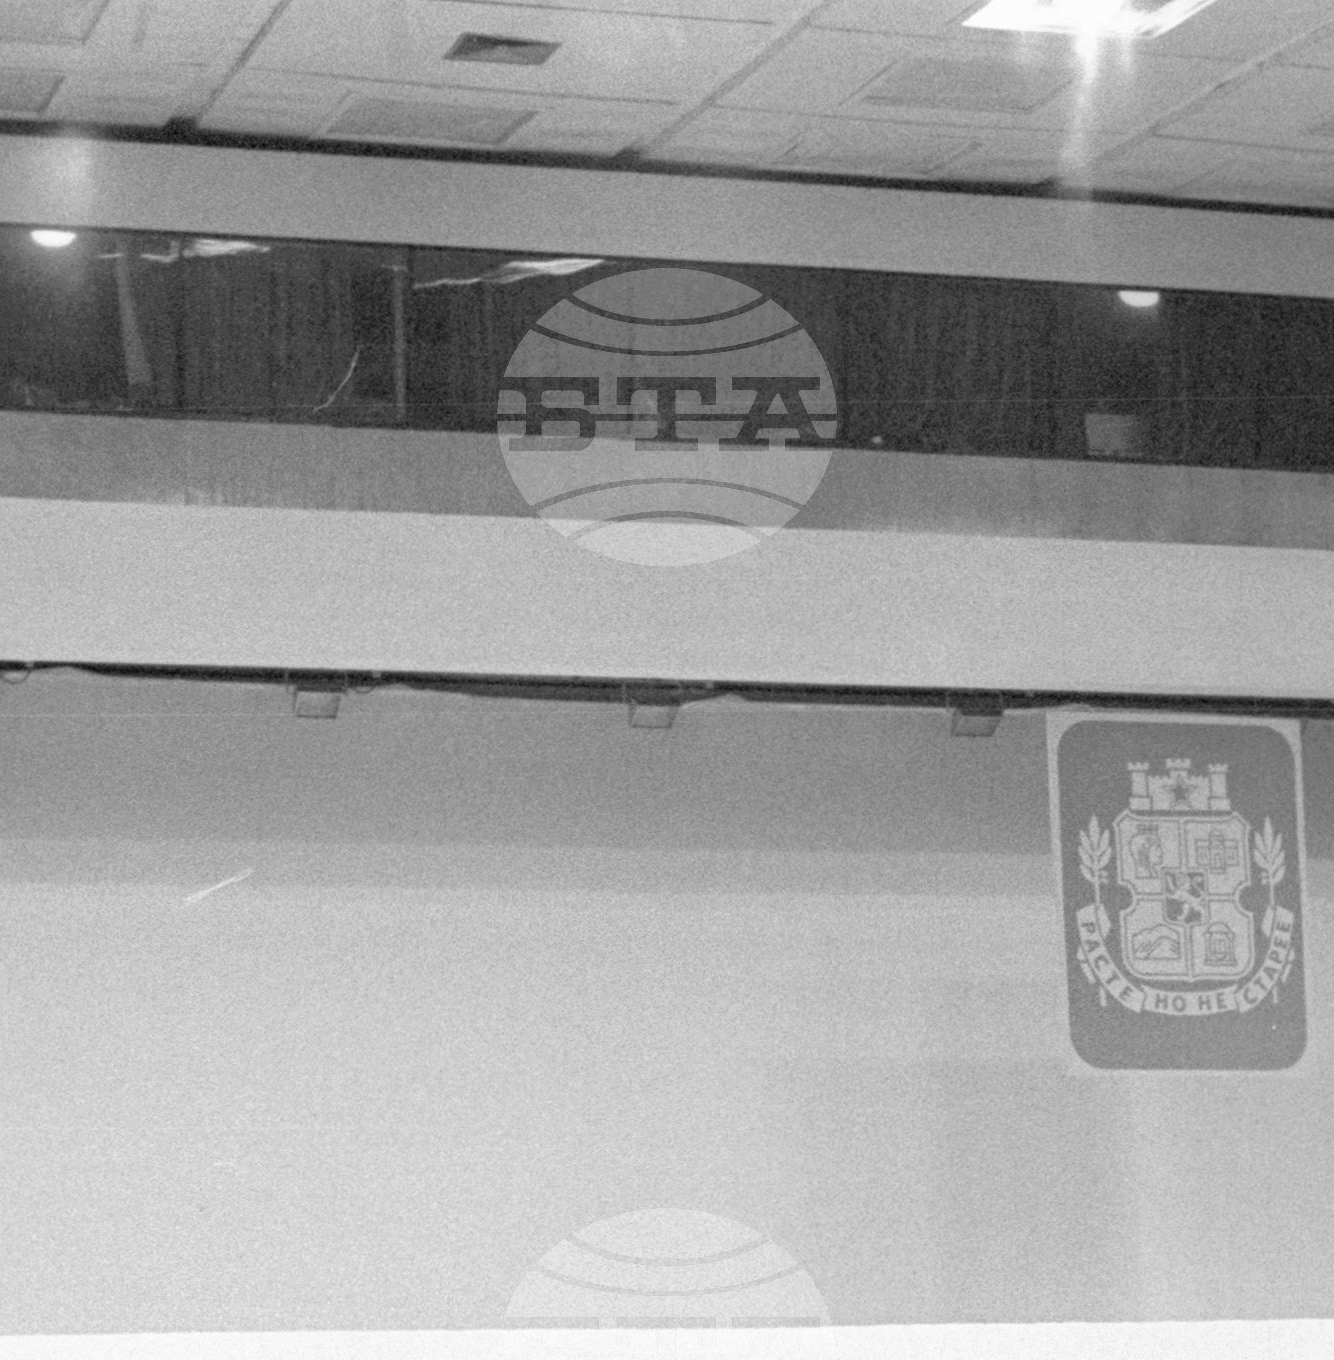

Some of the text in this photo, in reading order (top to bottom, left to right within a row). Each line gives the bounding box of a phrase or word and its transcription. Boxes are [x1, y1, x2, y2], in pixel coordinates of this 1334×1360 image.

[1081, 921, 1292, 1012] РАСТЕ НО НЕ СТАРЕЕ
